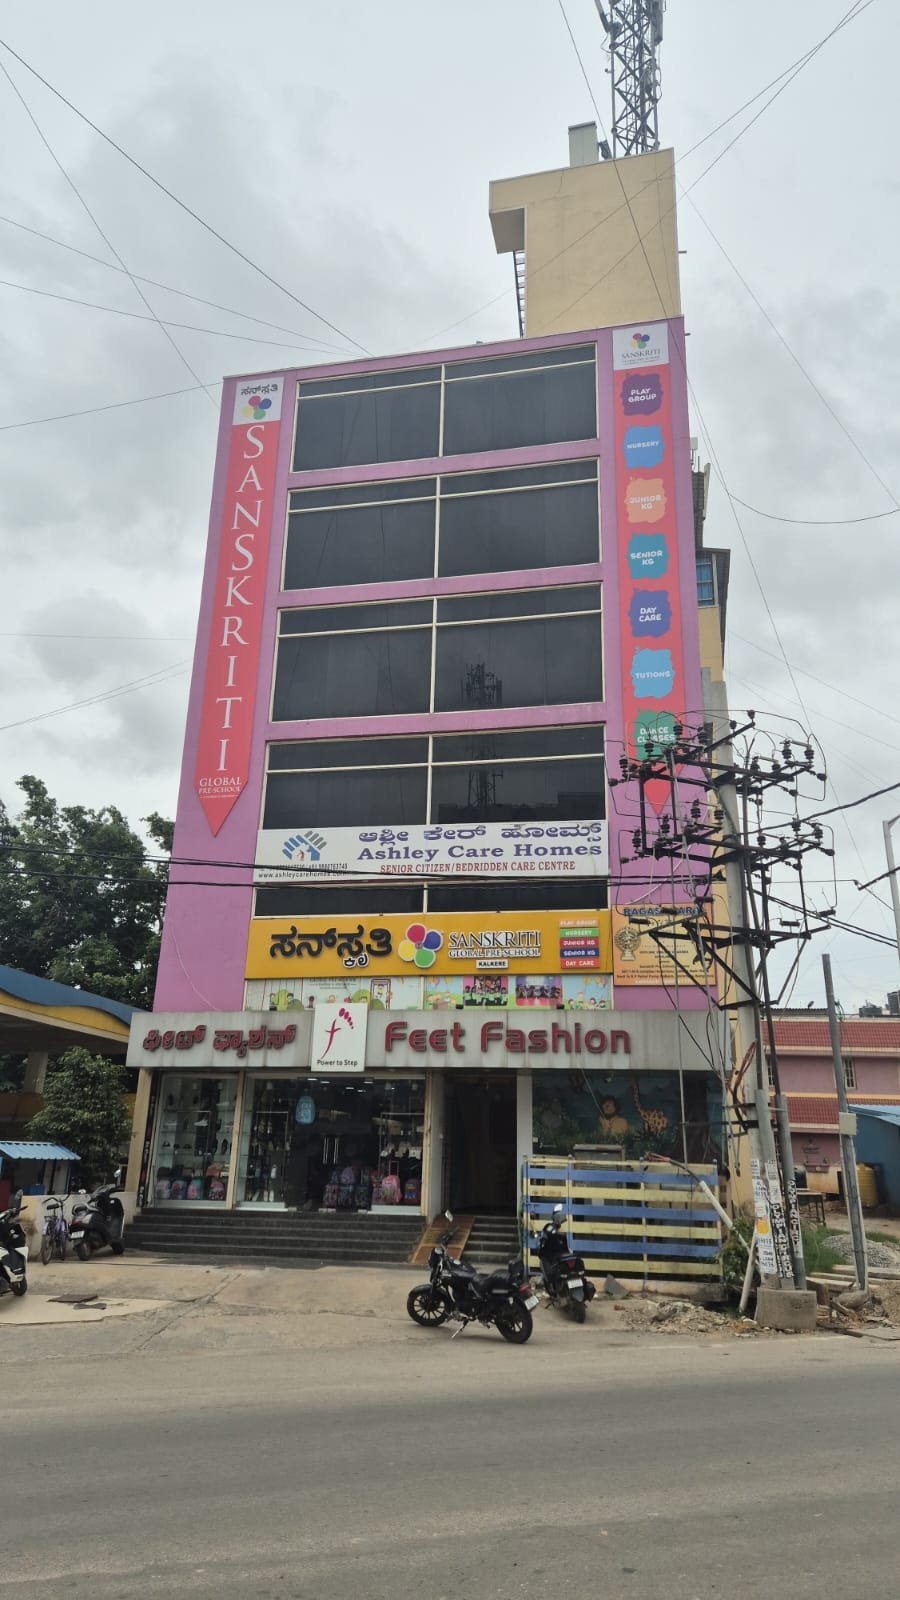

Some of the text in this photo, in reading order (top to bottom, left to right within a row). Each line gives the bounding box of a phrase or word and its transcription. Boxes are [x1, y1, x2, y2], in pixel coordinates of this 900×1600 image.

[621, 348, 662, 360] SANSKRITI
[630, 387, 652, 396] PLAY
[628, 393, 657, 403] GROUP
[626, 440, 660, 450] NURSERY
[628, 494, 662, 504] JUNIOR
[640, 502, 653, 510] KG
[630, 550, 663, 560] SENIOR
[642, 558, 654, 566] KG
[640, 606, 657, 615] DAY
[638, 613, 662, 622] CARE
[635, 670, 671, 679] TUTIONS
[636, 734, 676, 743] CLSSES
[199, 776, 242, 787] GLOBAL
[423, 825, 487, 841] ಕೇರ್
[357, 843, 602, 862] Ashley Care Homes
[380, 864, 413, 873] SENIOR
[510, 861, 536, 871] CARE
[538, 860, 576, 870] CENTRE
[448, 930, 541, 949] SANSKRITI
[448, 949, 484, 958] GLOBAL
[384, 1021, 632, 1054] Feet Fashion
[343, 1059, 358, 1067] Step
